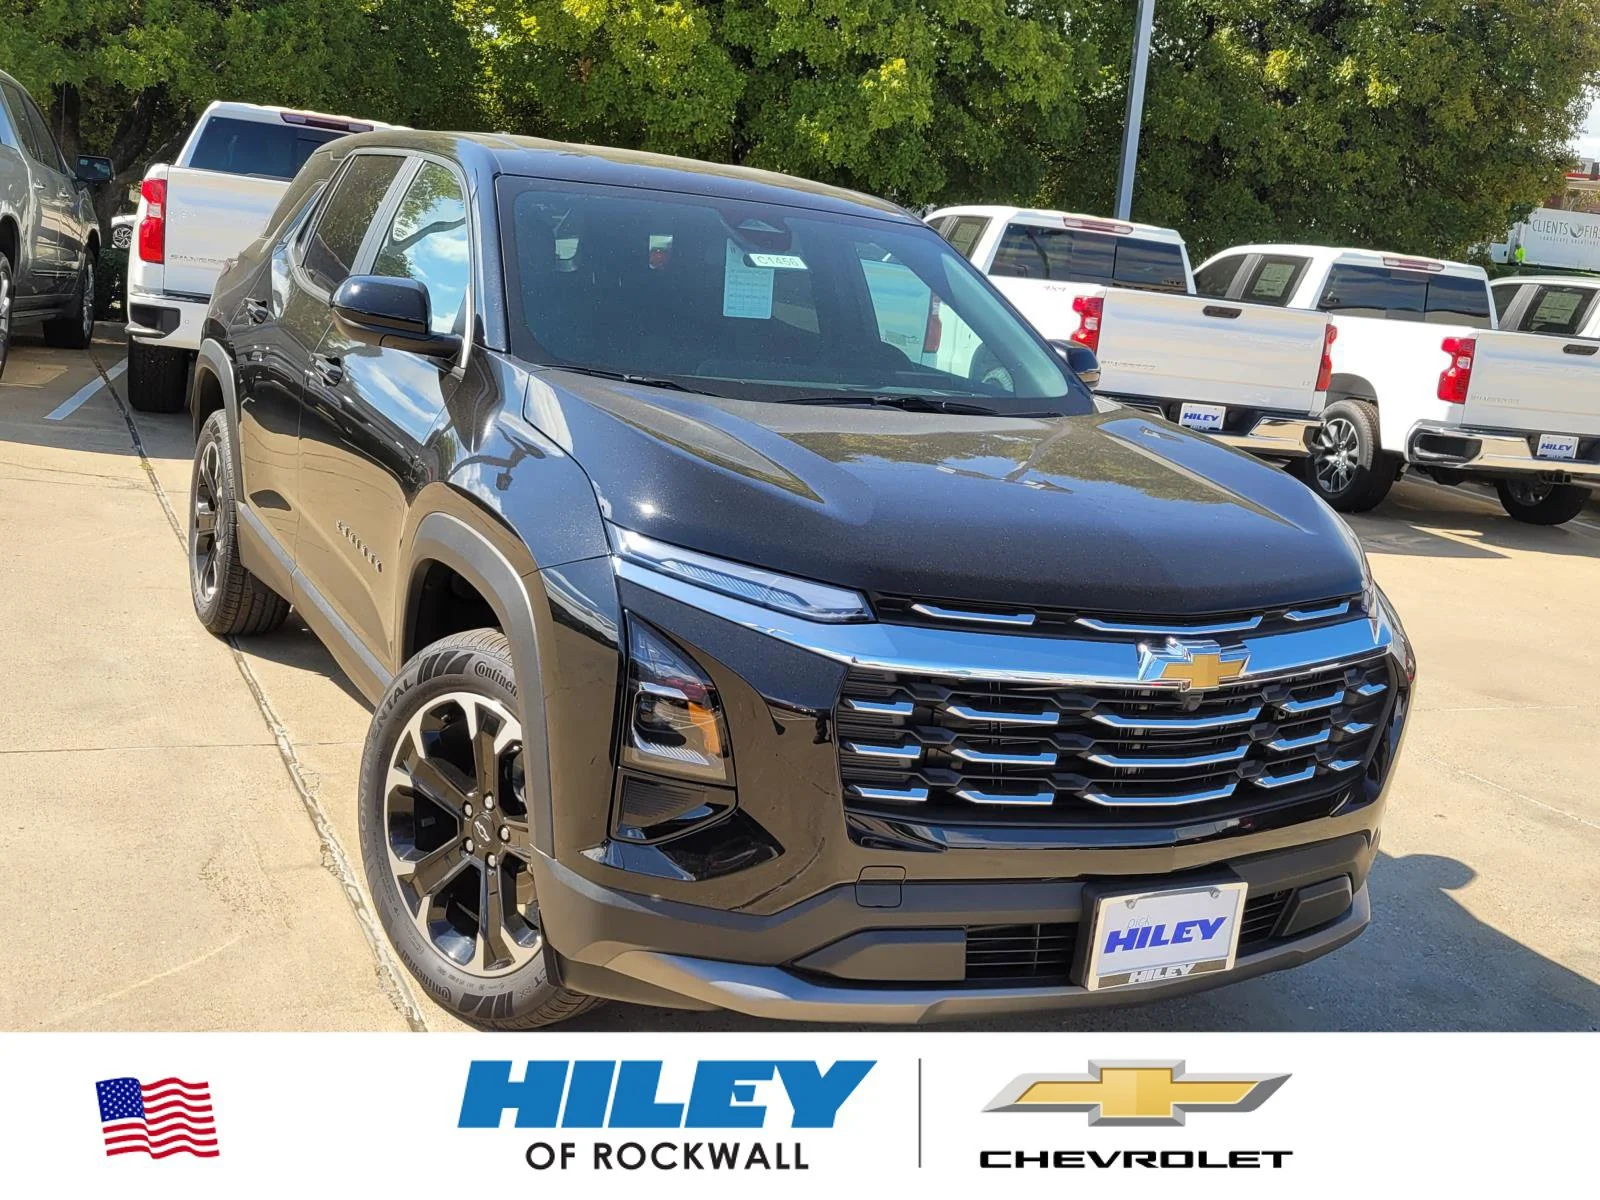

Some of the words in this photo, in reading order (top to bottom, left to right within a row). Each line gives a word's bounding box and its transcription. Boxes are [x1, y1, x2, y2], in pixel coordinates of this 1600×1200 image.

[1532, 219, 1568, 235] CLIENTS
[1183, 412, 1220, 422] HILEY
[1541, 443, 1573, 452] HILEY
[1103, 916, 1228, 954] HILEY
[1128, 963, 1196, 983] HILEY
